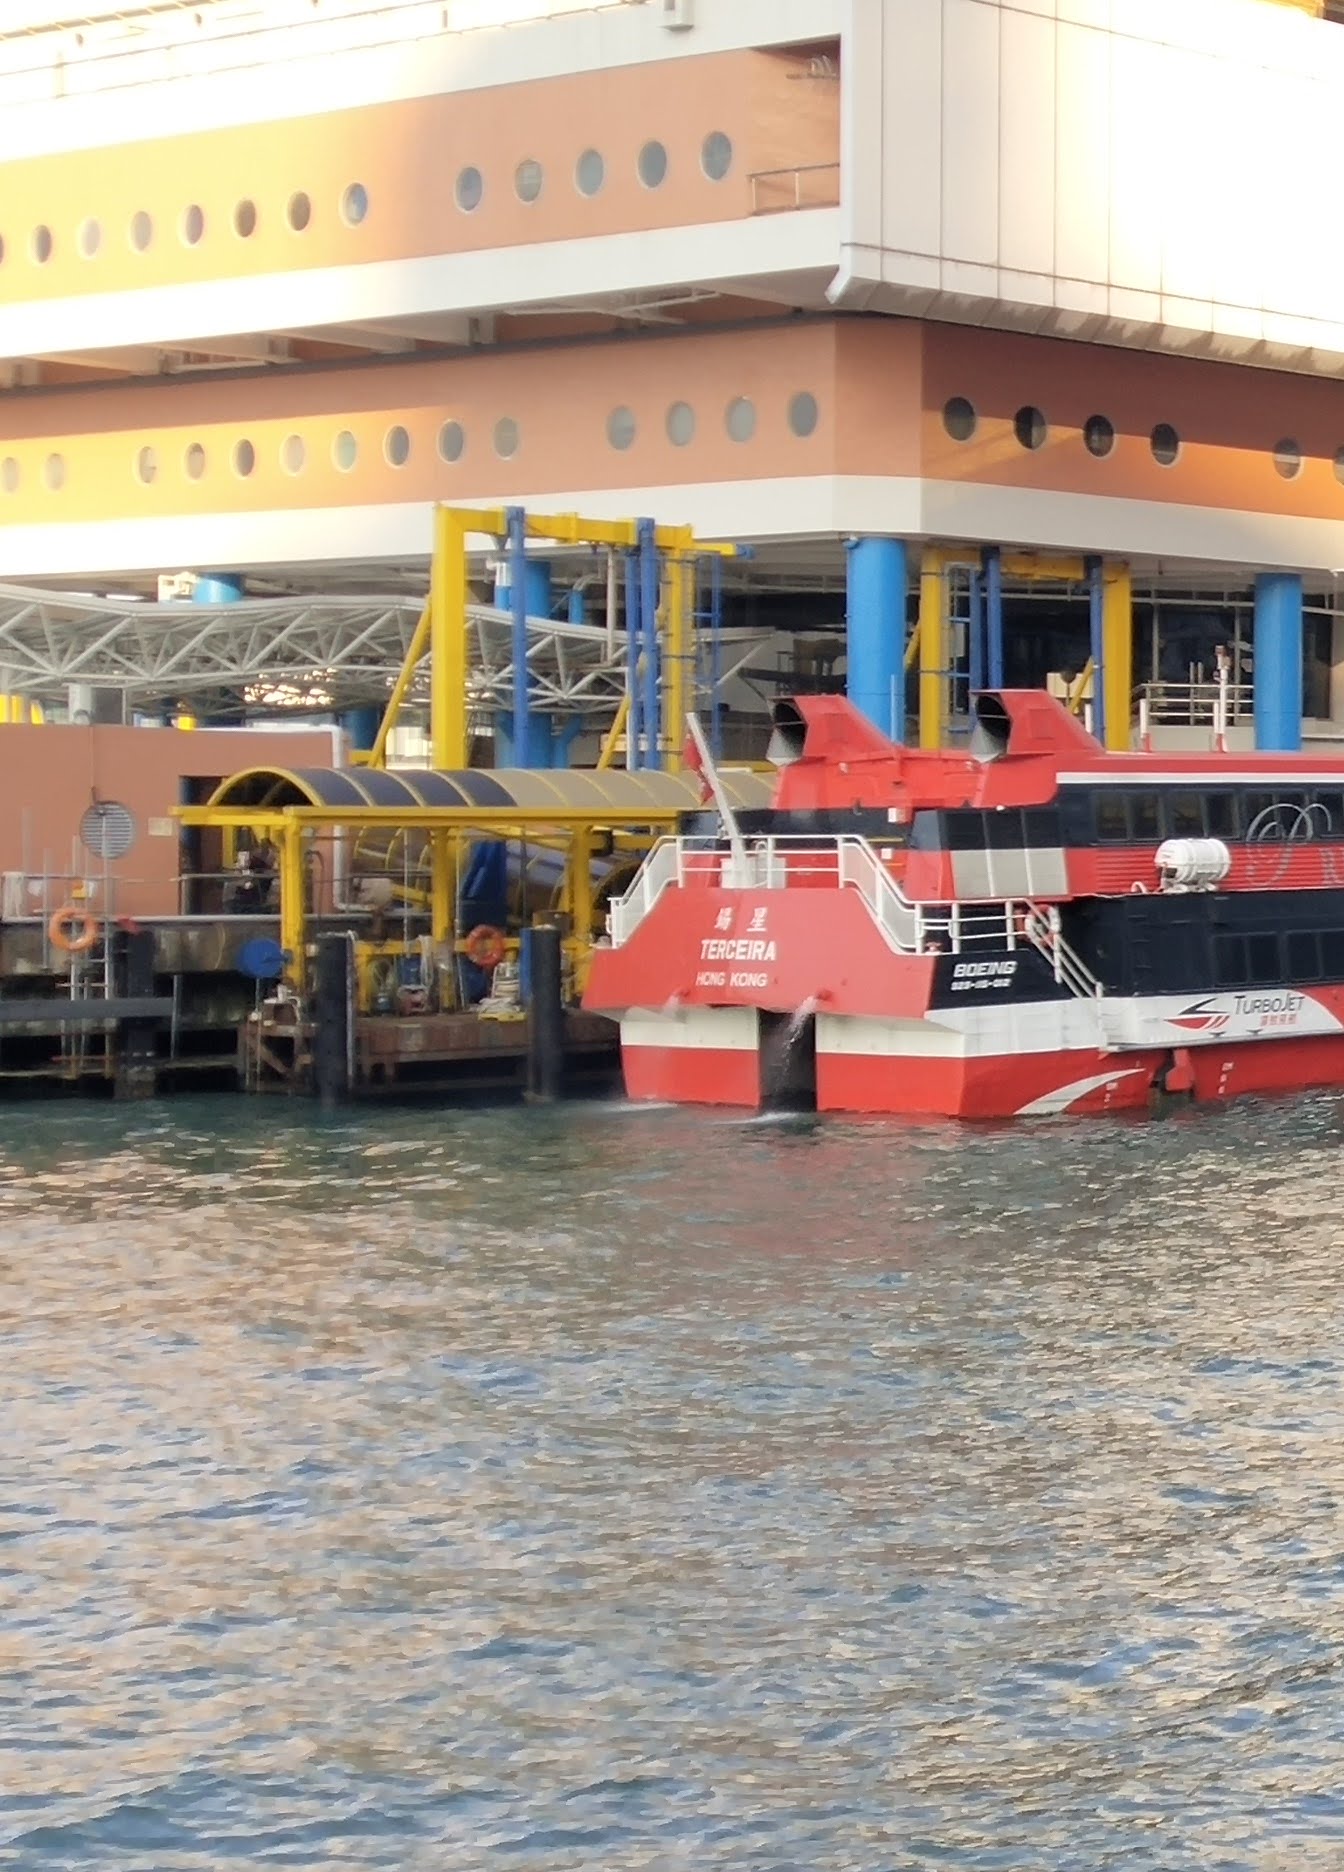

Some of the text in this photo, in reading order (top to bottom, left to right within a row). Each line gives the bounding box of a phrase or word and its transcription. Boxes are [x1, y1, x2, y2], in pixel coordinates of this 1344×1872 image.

[700, 939, 776, 960] TERCEIRA
[953, 960, 1018, 978] BOEING
[695, 972, 768, 987] HONG KONG
